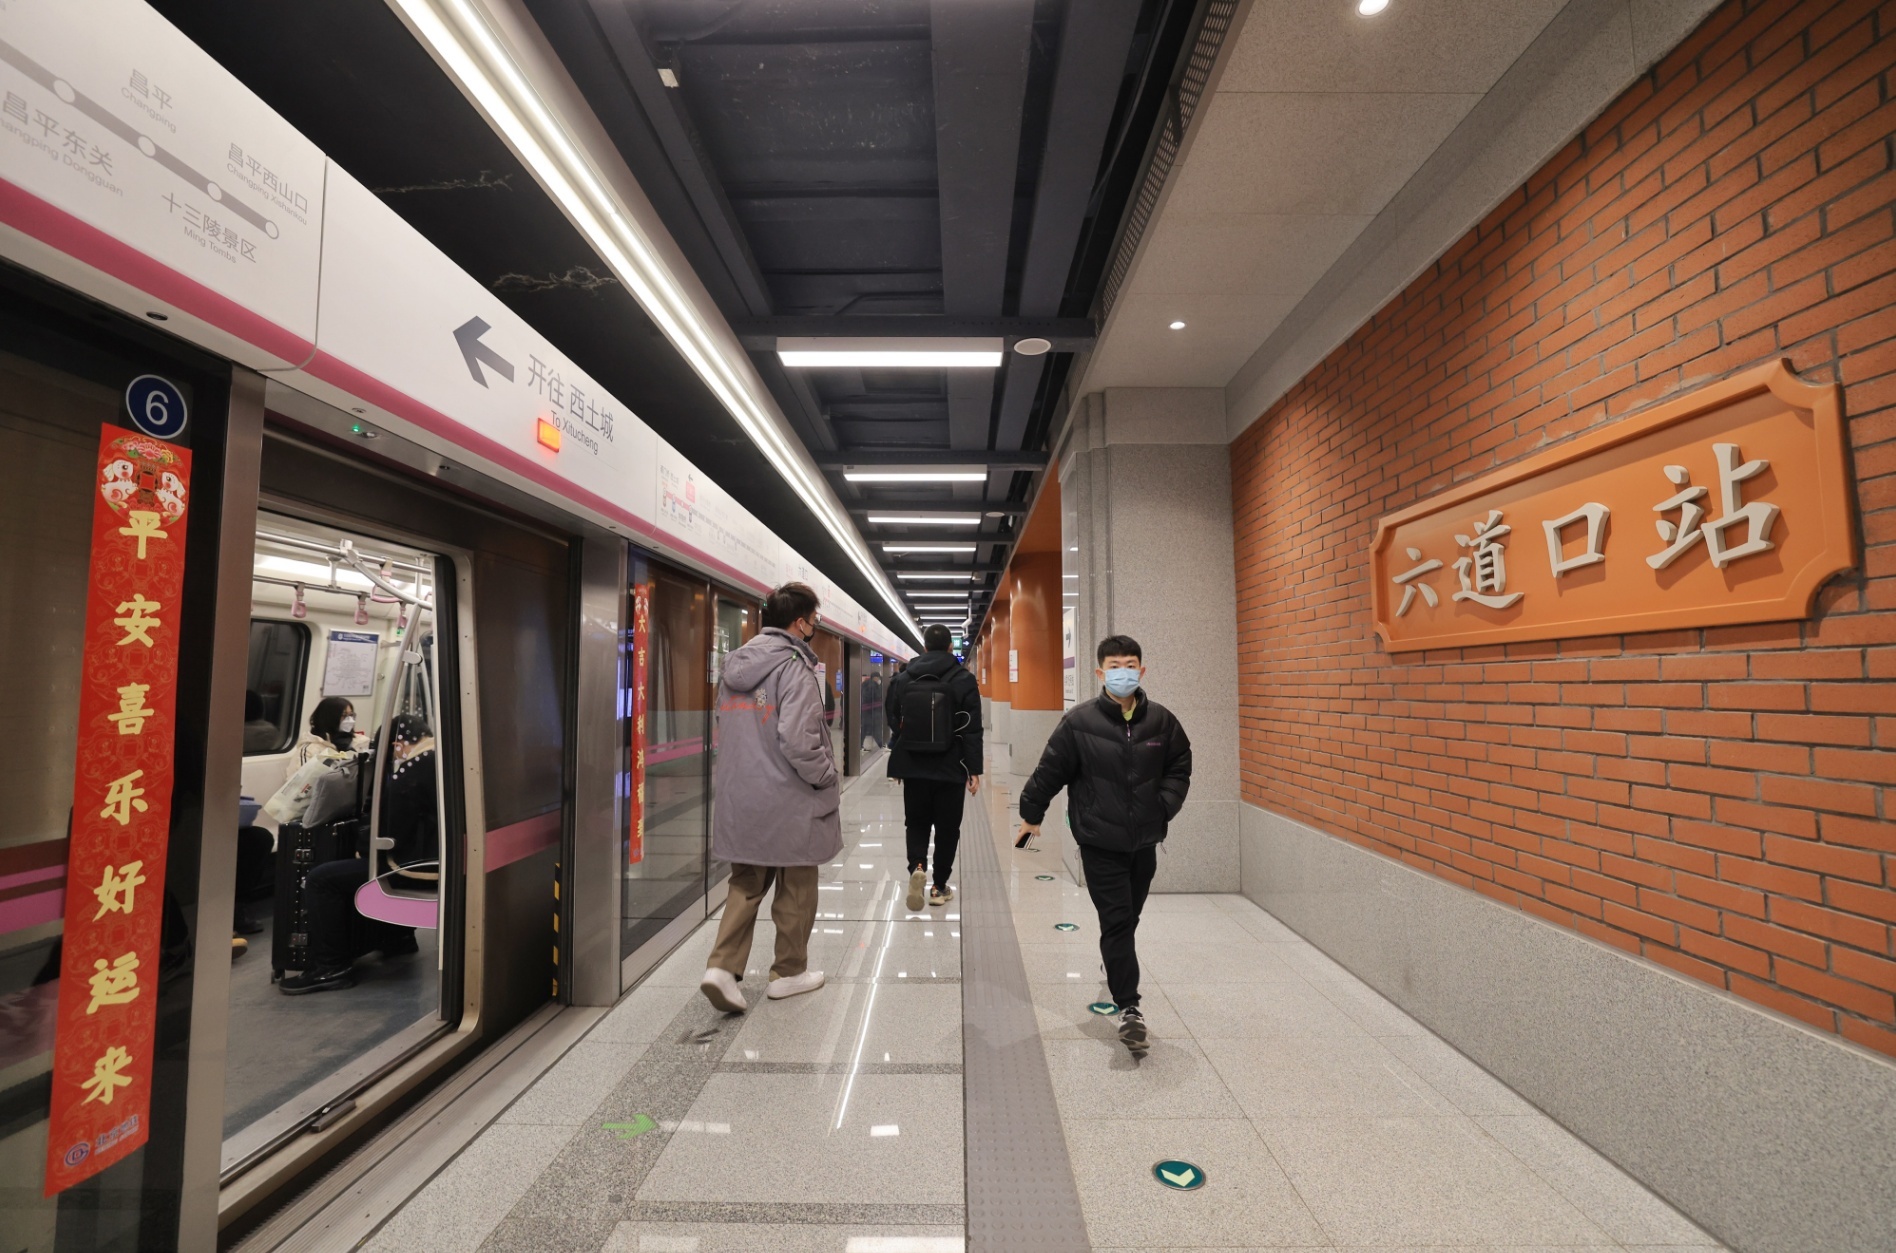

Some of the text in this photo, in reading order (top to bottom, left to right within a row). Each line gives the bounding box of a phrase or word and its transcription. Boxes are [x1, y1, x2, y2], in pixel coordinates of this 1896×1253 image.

[120, 87, 177, 134] Changping
[129, 68, 173, 110] 昌平
[2, 90, 114, 177] 昌平东关
[62, 153, 124, 197] Dongguan
[226, 162, 307, 226] Changping Xishankou
[228, 142, 308, 214] 昌平西山口
[160, 191, 258, 264] 十三陵景区
[183, 225, 237, 264] Ming Tombs
[145, 390, 169, 426] 6
[527, 353, 615, 443] 开往 西土城
[550, 409, 599, 456] To Xitucheng
[1392, 442, 1780, 617] 六道口站
[80, 509, 169, 1106] 平安喜乐好运来
